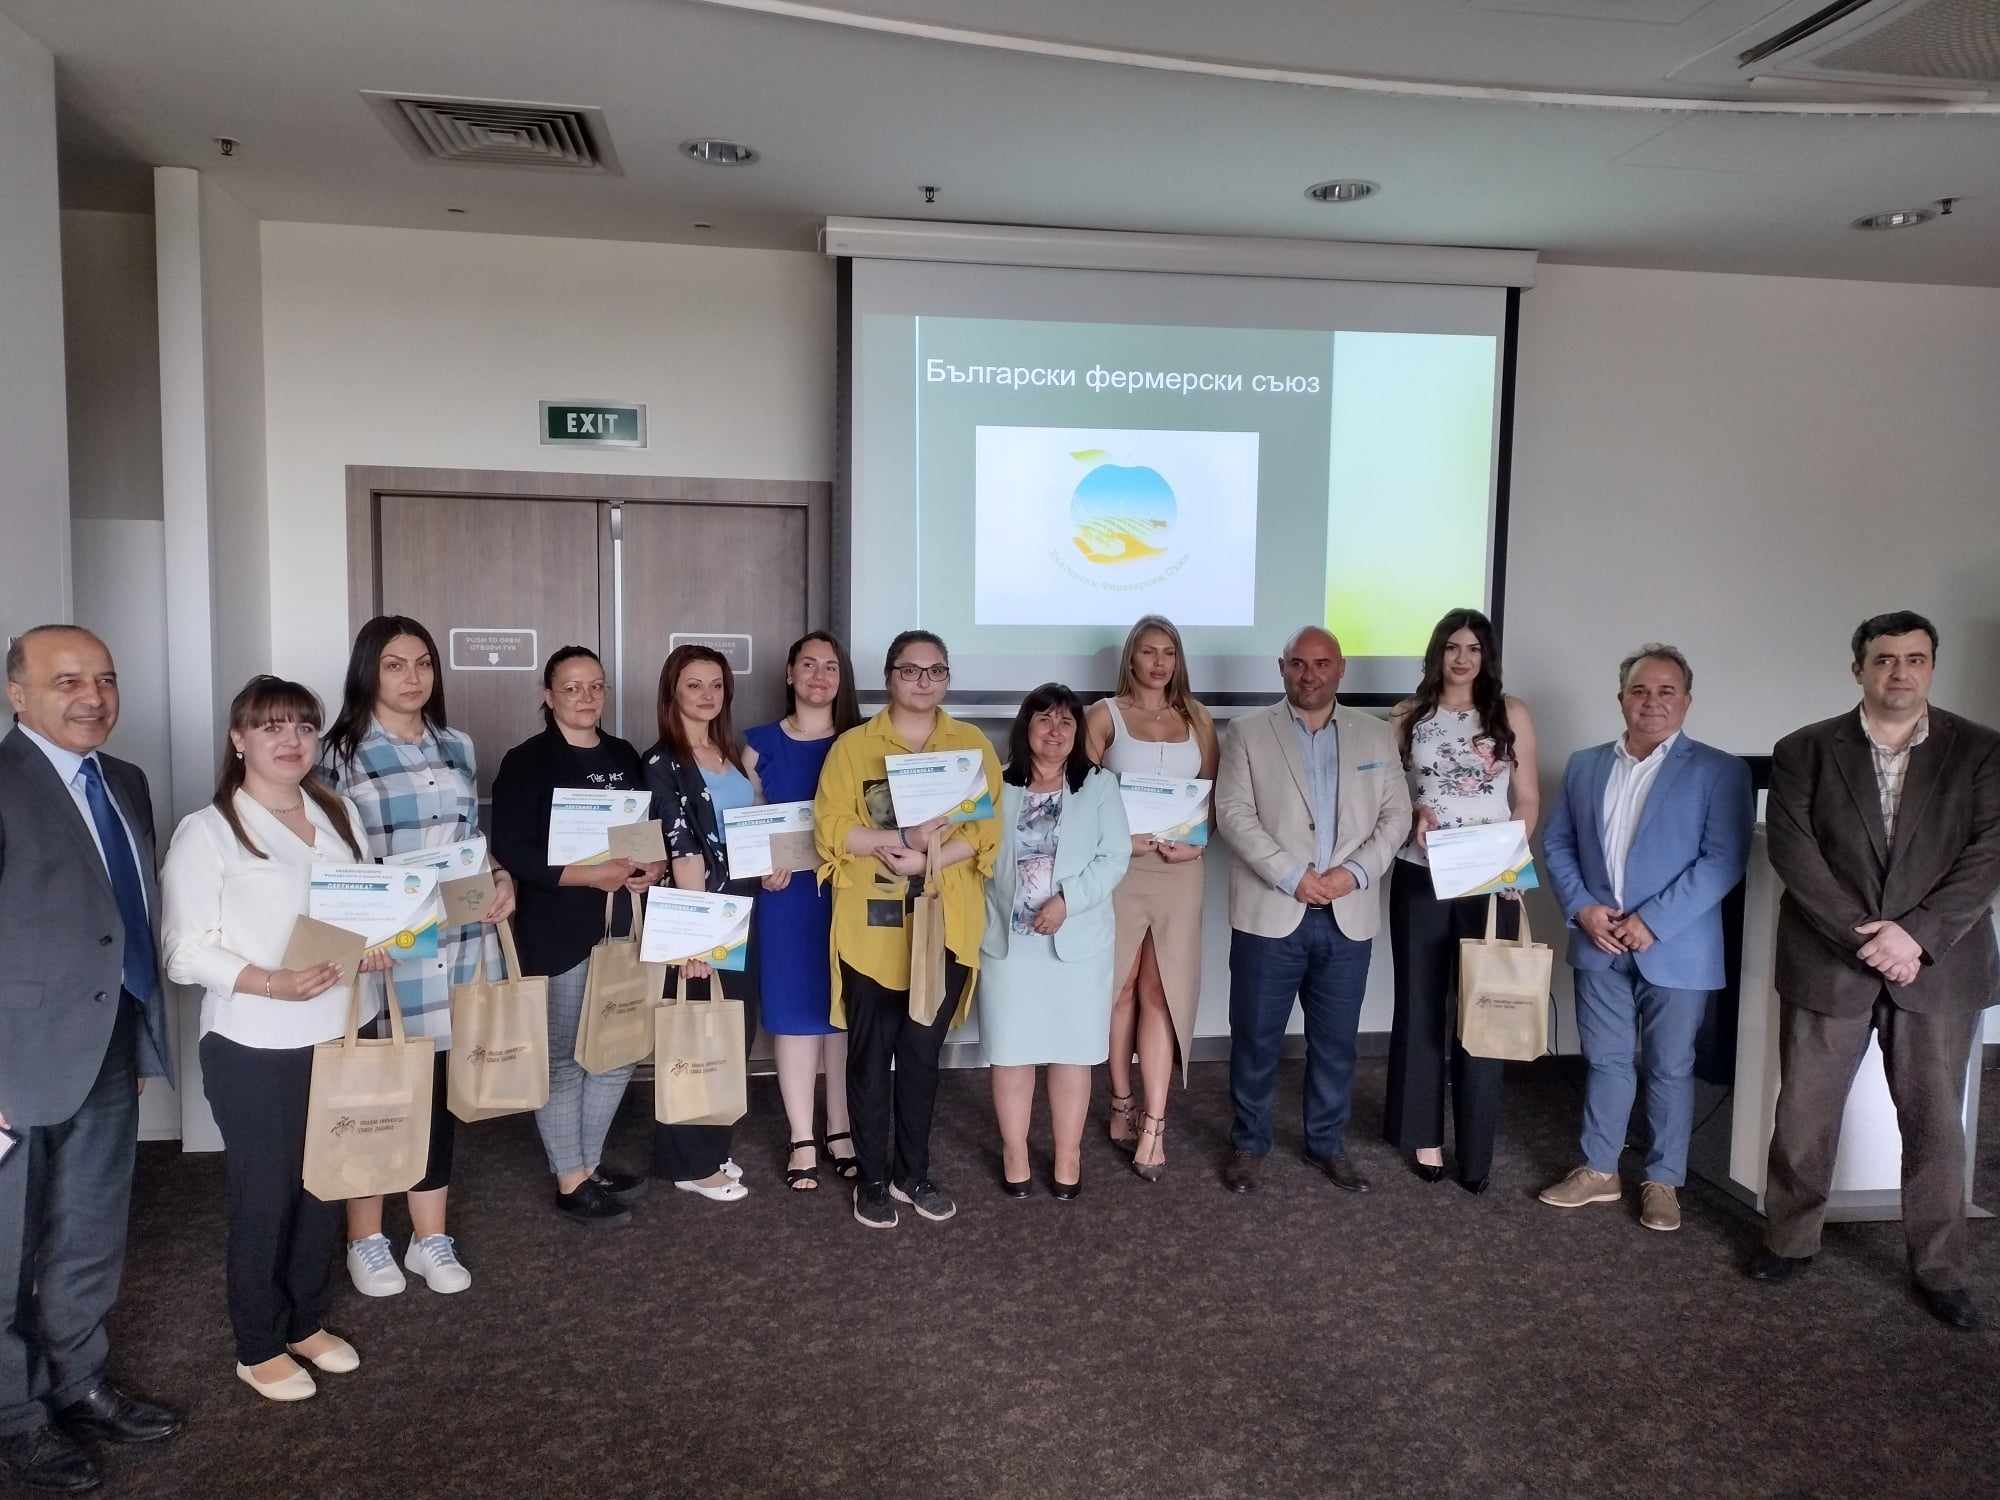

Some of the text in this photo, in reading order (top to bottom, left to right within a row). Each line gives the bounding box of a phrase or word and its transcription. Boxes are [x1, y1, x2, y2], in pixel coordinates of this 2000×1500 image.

[927, 358, 1321, 396] Български фермерски съюз
[567, 412, 618, 433] EXIT
[586, 772, 606, 783] THE
